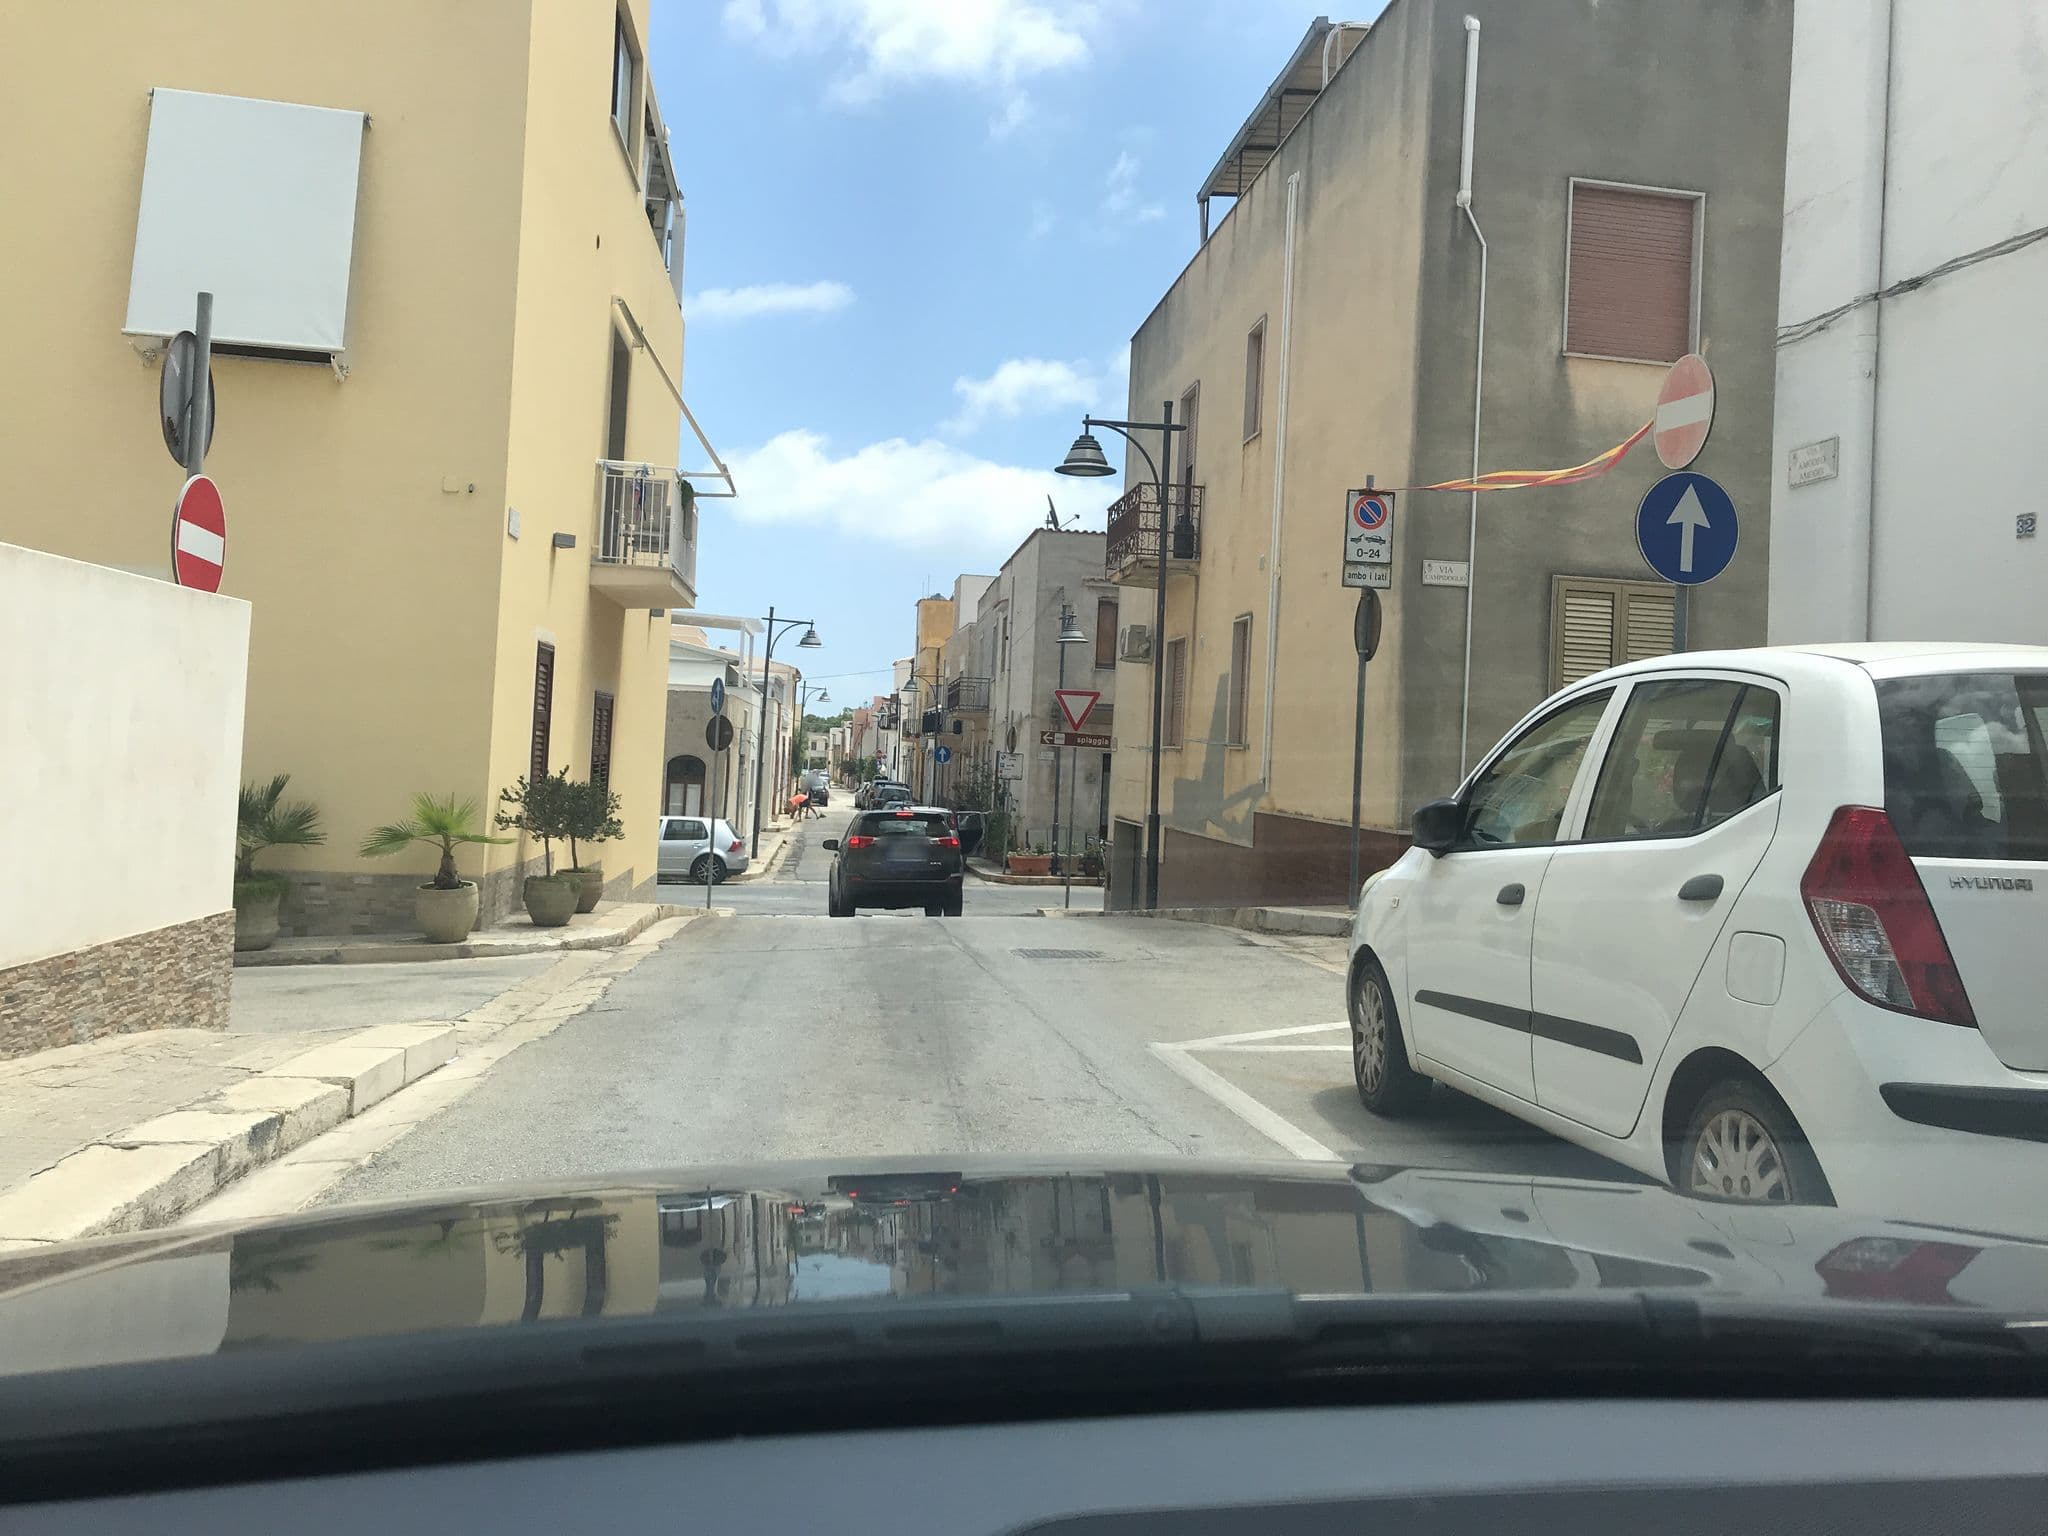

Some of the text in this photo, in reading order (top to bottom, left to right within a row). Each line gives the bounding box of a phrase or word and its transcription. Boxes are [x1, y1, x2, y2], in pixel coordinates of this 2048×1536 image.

[1356, 548, 1381, 558] 0-24
[1439, 566, 1453, 574] VIA
[1347, 571, 1367, 580] ambo
[1374, 572, 1387, 581] lati
[1077, 737, 1109, 745] spiaggia
[1949, 876, 2033, 891] HYUNDAI
